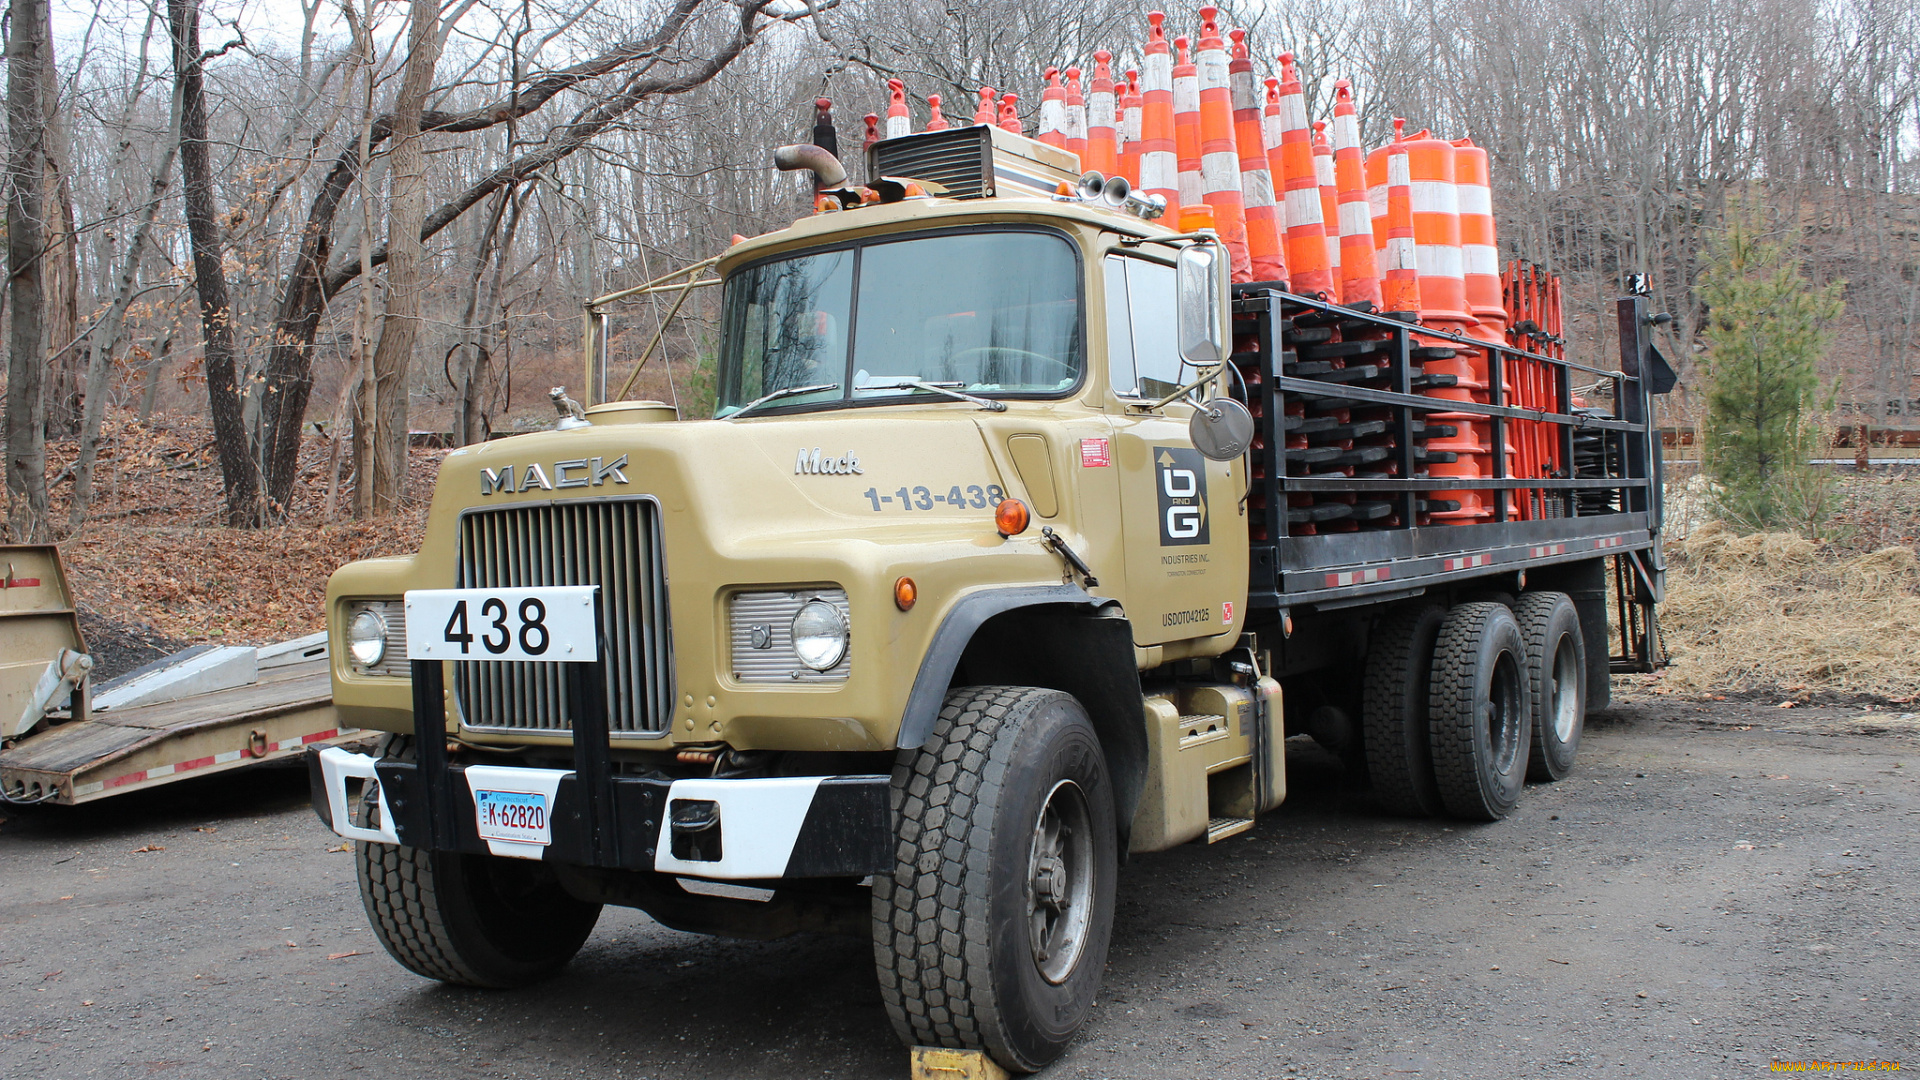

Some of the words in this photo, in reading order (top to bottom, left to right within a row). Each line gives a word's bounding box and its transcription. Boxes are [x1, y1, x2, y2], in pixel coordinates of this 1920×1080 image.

[480, 453, 629, 496] MACK
[795, 447, 864, 475] Mack
[863, 484, 1005, 512] 1-13-438
[1167, 505, 1199, 538] G
[1161, 554, 1198, 565] INDUSTRIES
[444, 597, 550, 656] 438
[495, 794, 529, 803] Connecticut
